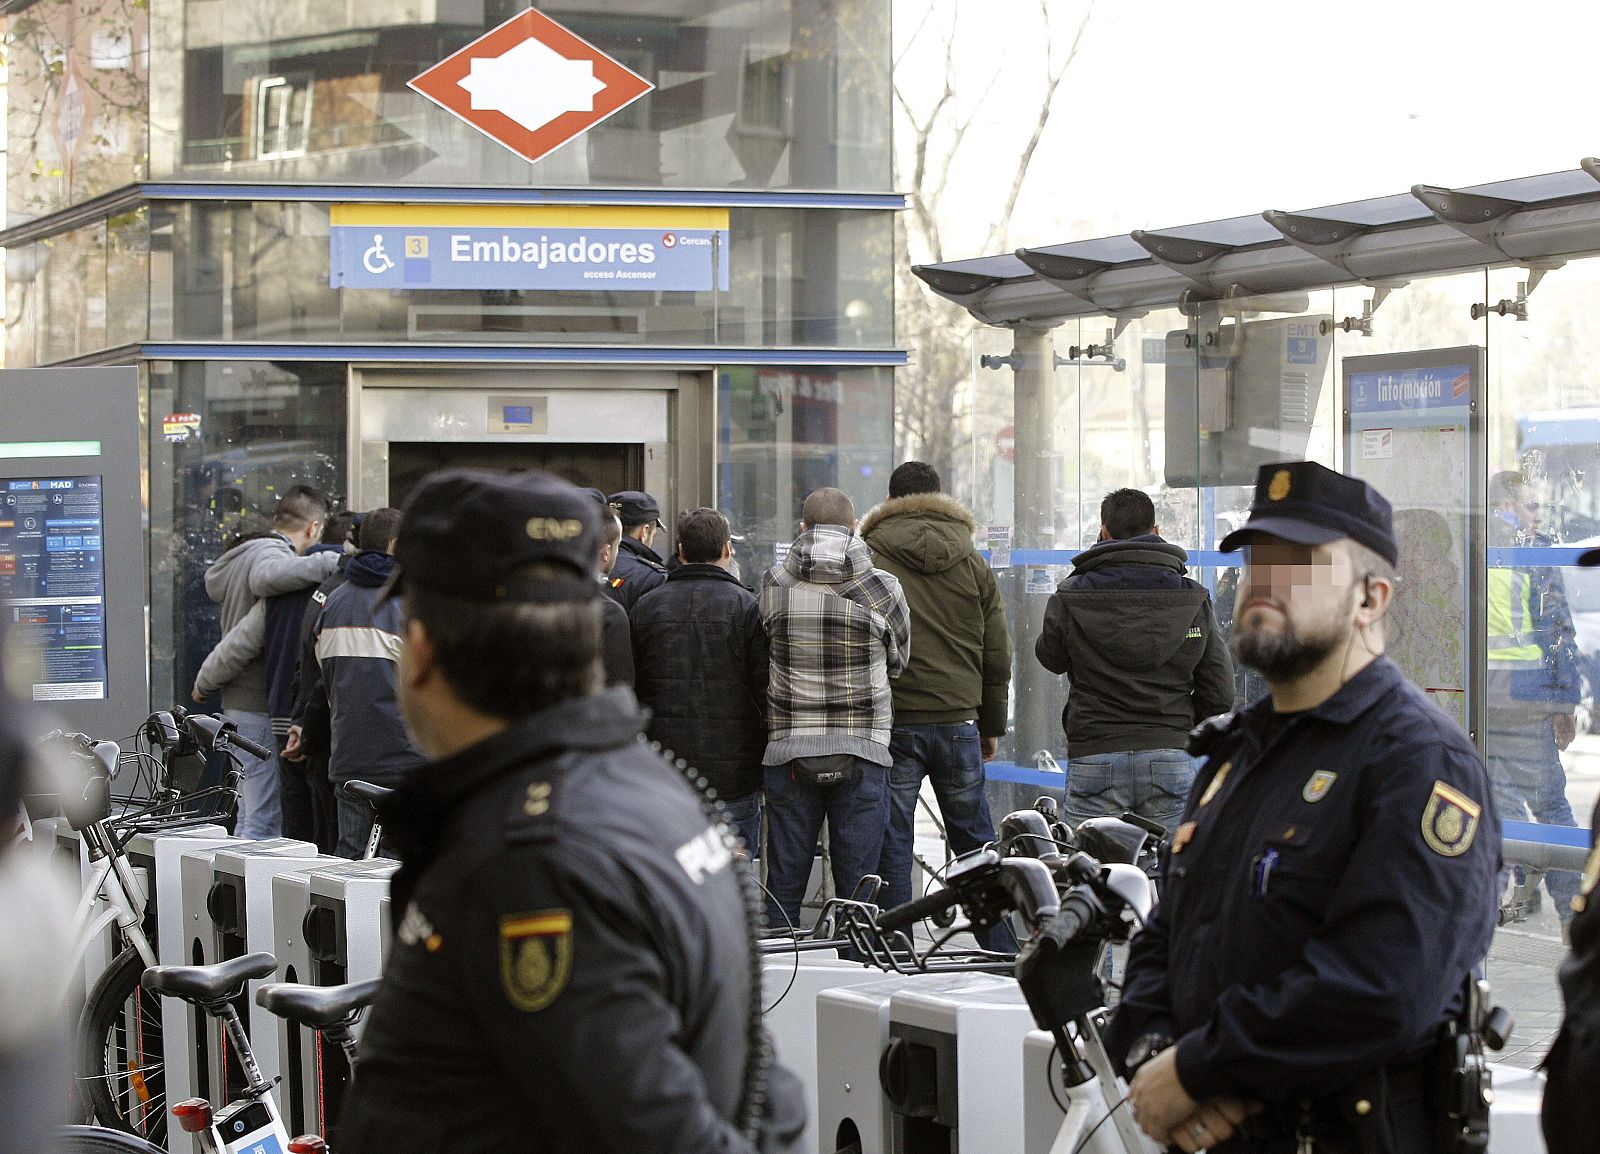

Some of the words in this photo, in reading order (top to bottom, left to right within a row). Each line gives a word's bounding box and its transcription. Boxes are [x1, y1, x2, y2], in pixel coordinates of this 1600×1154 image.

[411, 238, 422, 255] 3
[450, 234, 656, 269] Embajadores
[583, 271, 614, 279] acceso
[615, 269, 656, 279] Ascensor
[1287, 323, 1317, 337] EMT
[1377, 373, 1441, 402] Información
[50, 481, 72, 489] MAD
